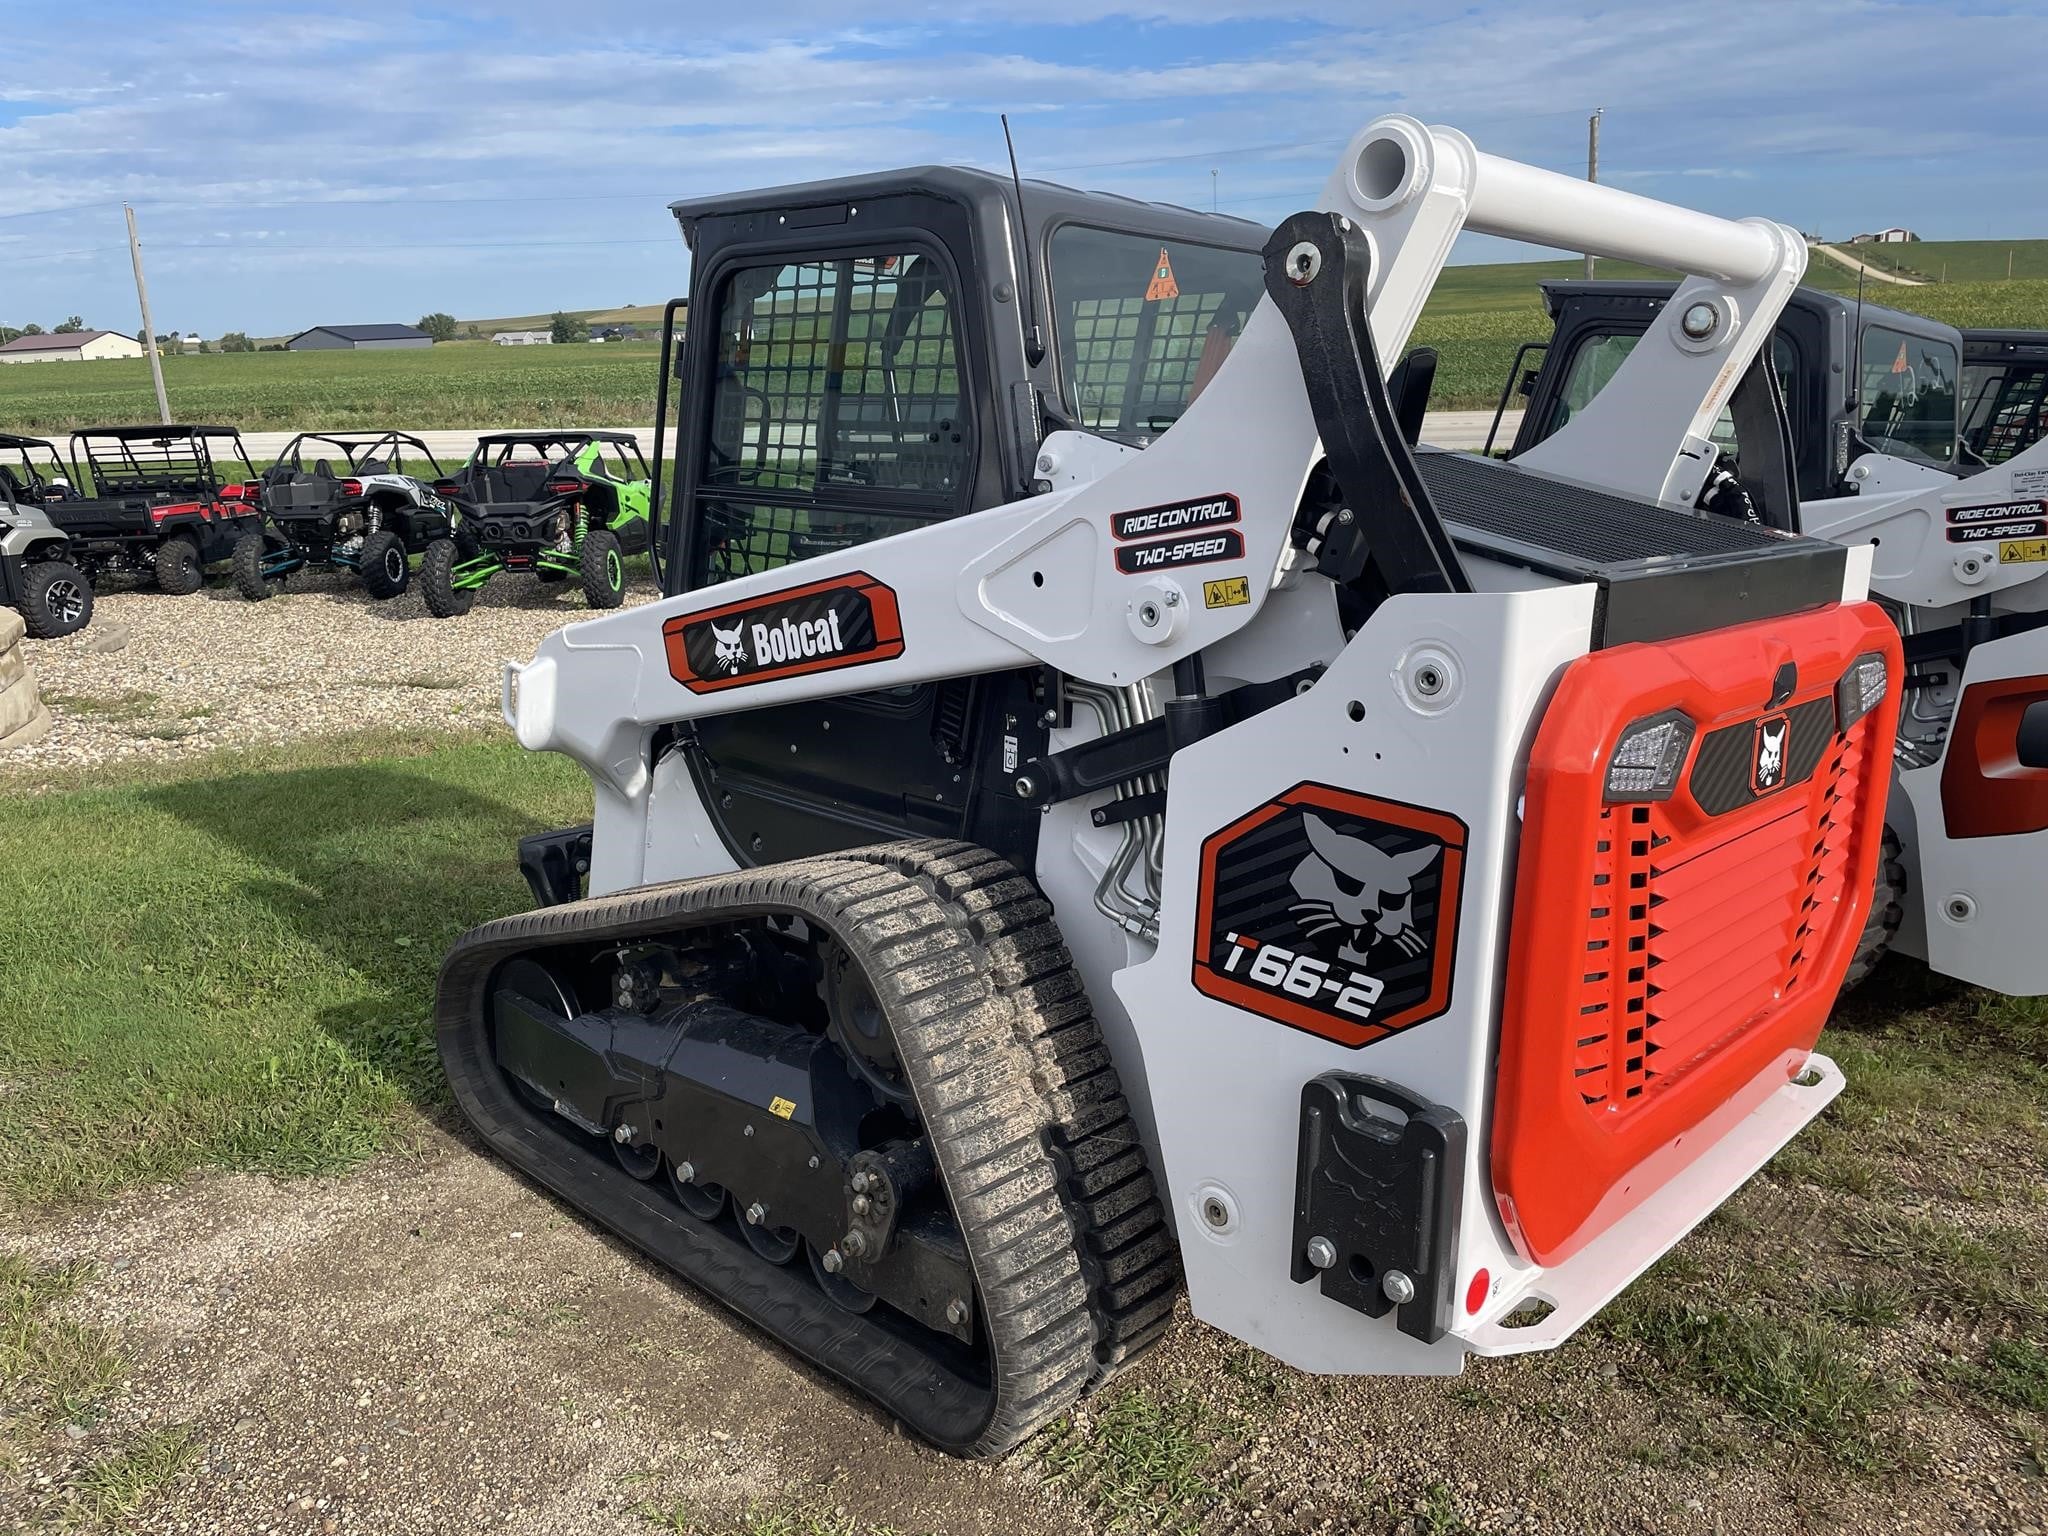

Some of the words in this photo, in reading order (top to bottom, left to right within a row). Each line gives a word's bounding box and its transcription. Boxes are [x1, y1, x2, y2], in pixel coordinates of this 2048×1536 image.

[1123, 514, 1159, 534] RIDE
[1158, 501, 1232, 528] CONTROL
[1955, 510, 1984, 521] RIDE
[1984, 503, 2043, 517] CONTROL
[1962, 523, 2037, 539] TWO-SPEED
[1135, 537, 1227, 566] TWO-SPEED
[751, 608, 843, 667] Bobcat
